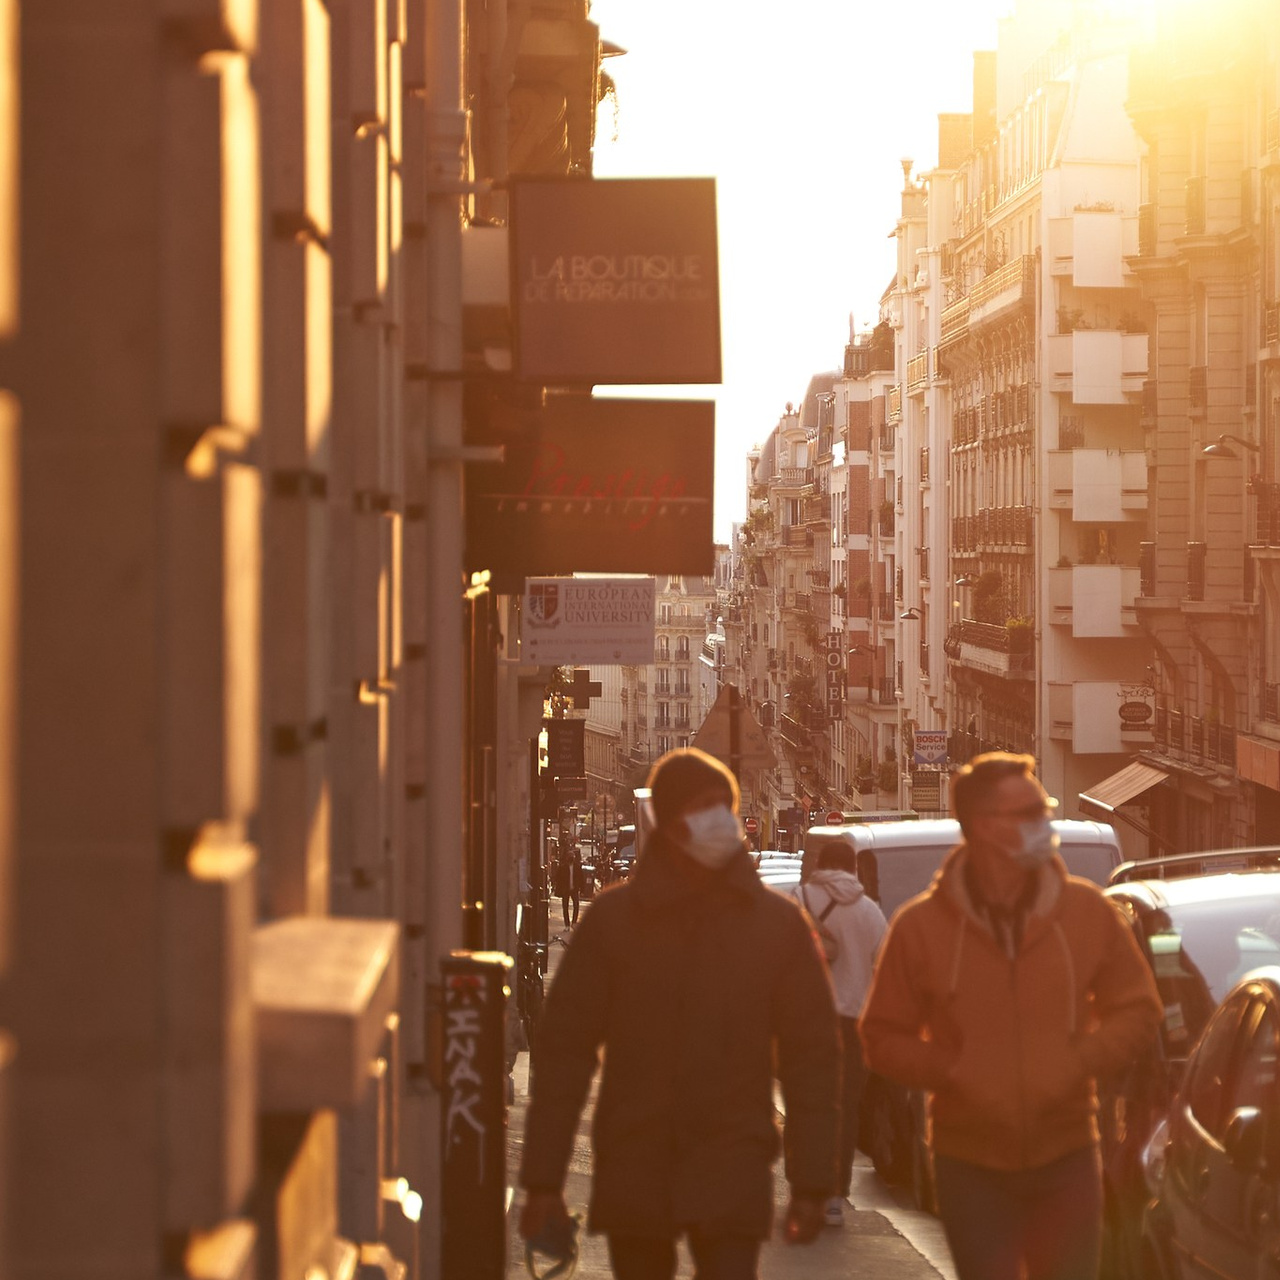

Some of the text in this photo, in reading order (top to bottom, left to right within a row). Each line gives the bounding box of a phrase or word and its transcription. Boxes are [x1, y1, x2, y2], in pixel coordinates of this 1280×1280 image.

[531, 254, 702, 280] LA BOUTIQUE
[525, 280, 549, 303] DE
[522, 442, 688, 530] Prestige
[564, 588, 652, 600] EUROPEAN
[564, 601, 652, 610] INTERNATIONAL
[564, 611, 653, 623] UNIVERSITY
[827, 635, 841, 718] HOTEL
[916, 735, 946, 743] BOSCH
[916, 743, 946, 751] Service
